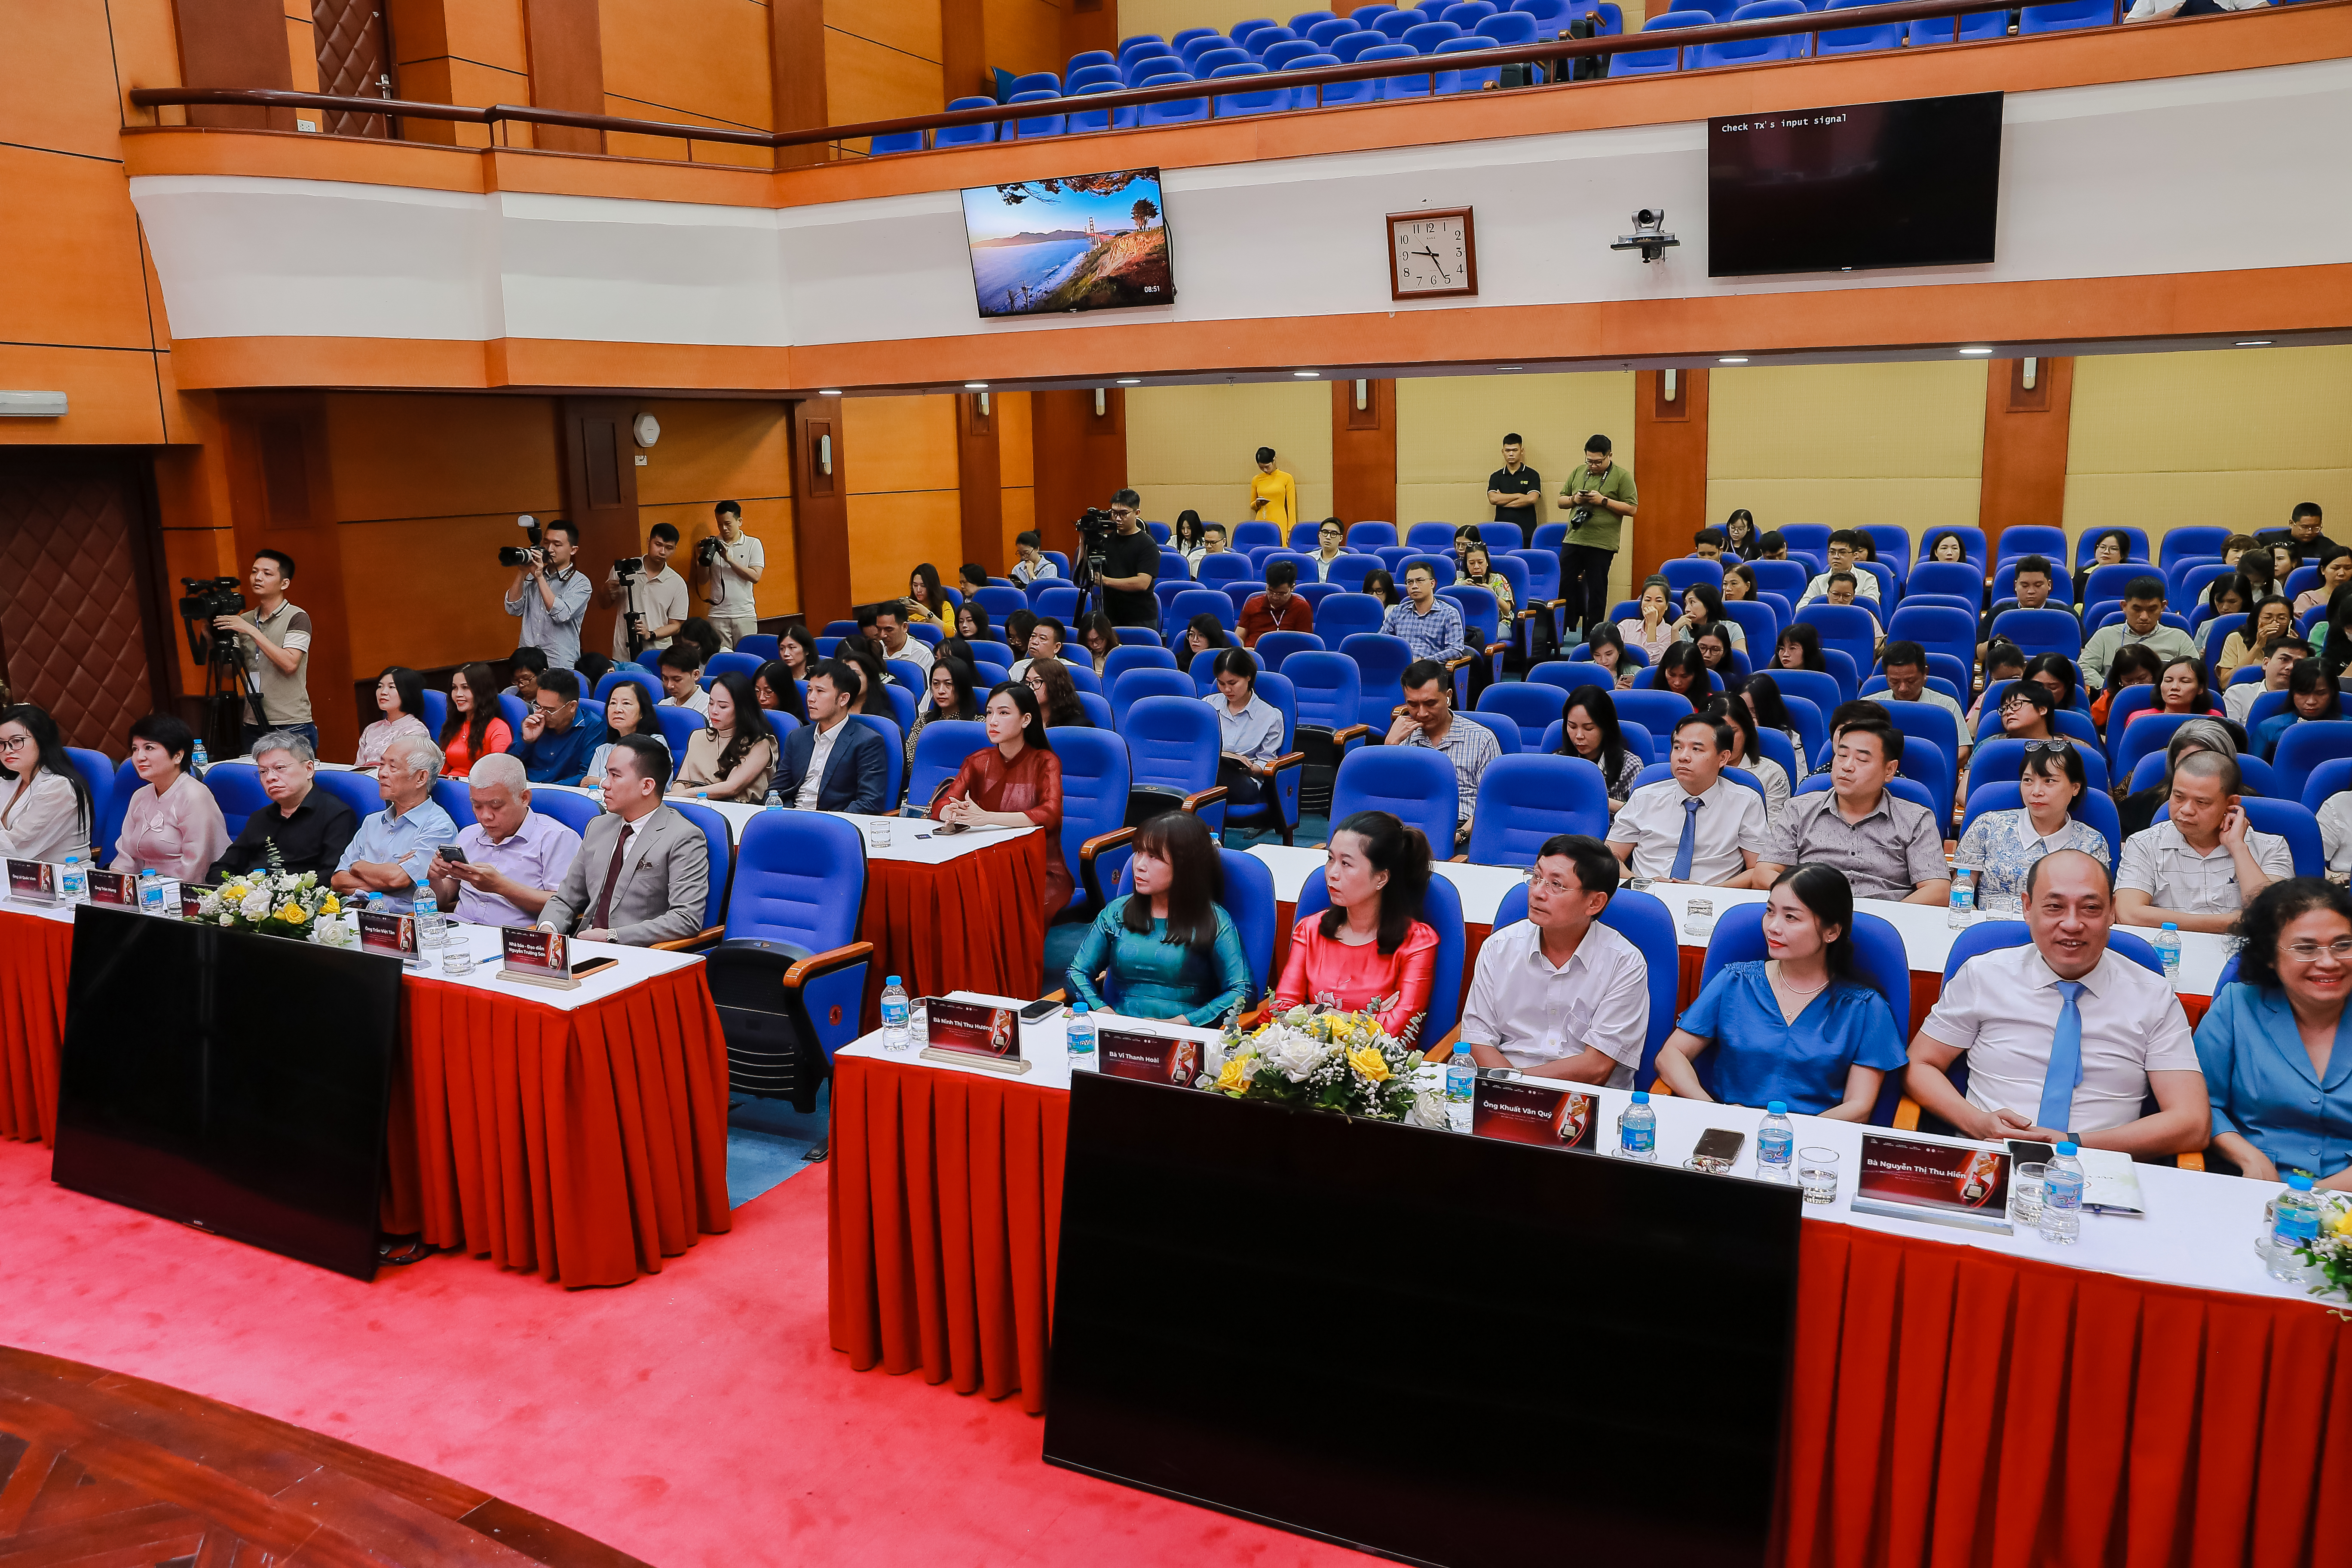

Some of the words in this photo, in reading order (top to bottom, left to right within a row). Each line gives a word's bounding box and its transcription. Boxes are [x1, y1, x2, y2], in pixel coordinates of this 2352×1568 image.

[1781, 118, 1808, 128] input
[1814, 114, 1847, 125] signal
[1412, 224, 1420, 234] 11
[1426, 223, 1435, 233] 12
[1443, 222, 1446, 231] 1
[1400, 235, 1409, 244] 10
[1455, 230, 1461, 240] 2
[1402, 251, 1409, 260] 9
[1456, 247, 1462, 257] 3
[1403, 268, 1410, 277] 8
[1456, 264, 1464, 273] 4
[1416, 276, 1422, 286] 7
[1430, 276, 1437, 285] 6
[1444, 274, 1451, 284] 5
[1483, 1100, 1498, 1110] Ông
[1500, 1104, 1521, 1113] Khuất
[1522, 1107, 1536, 1115] Văn
[1537, 1110, 1553, 1118] Quý
[1880, 1161, 1912, 1172] Nguyễn
[1914, 1166, 1927, 1175] Thị
[1929, 1168, 1945, 1176] Thu
